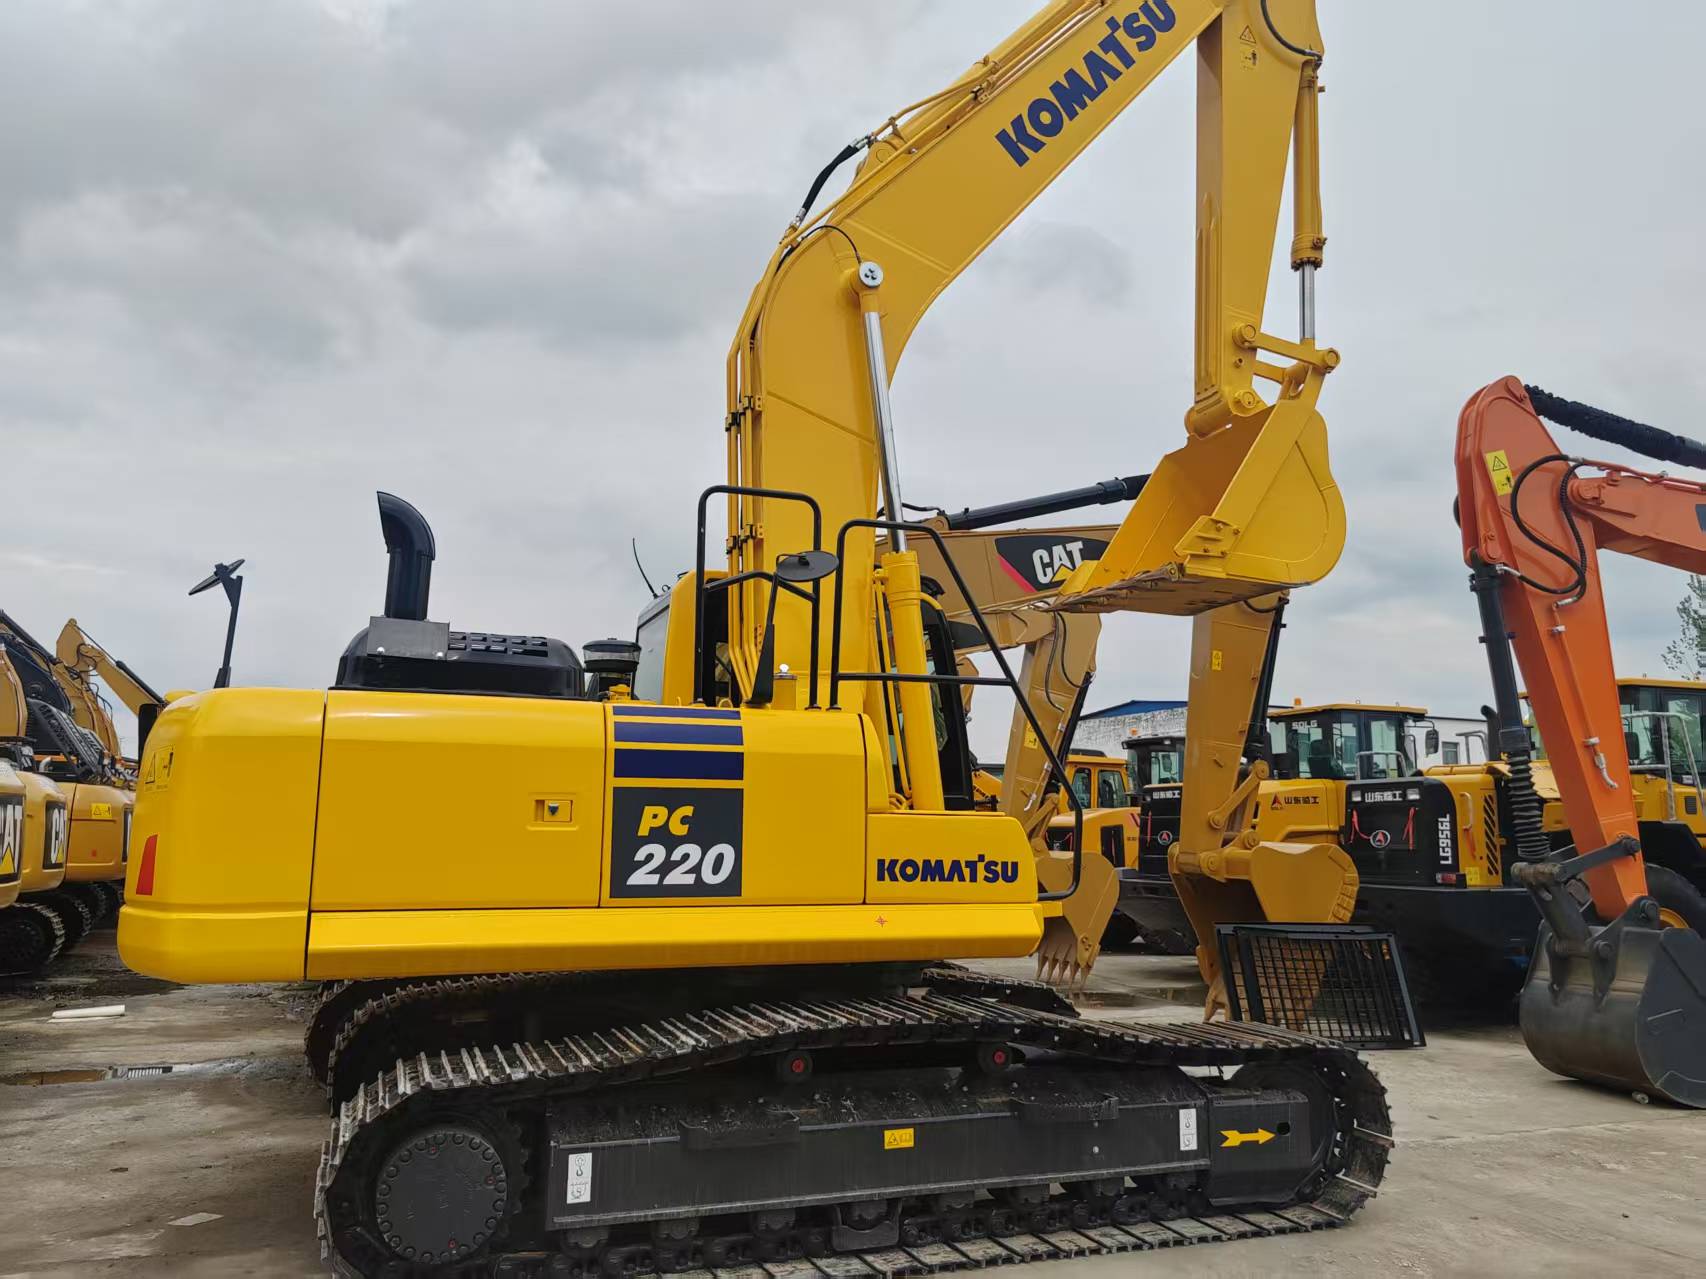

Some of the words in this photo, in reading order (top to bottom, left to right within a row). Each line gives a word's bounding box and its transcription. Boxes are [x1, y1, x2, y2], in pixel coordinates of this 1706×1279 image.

[995, 0, 1176, 167] KOMATSU
[1032, 541, 1084, 584] CAT
[637, 805, 694, 836] PC
[1438, 813, 1452, 865] LG956L
[626, 843, 736, 886] 220
[876, 854, 1018, 883] KOMATSU
